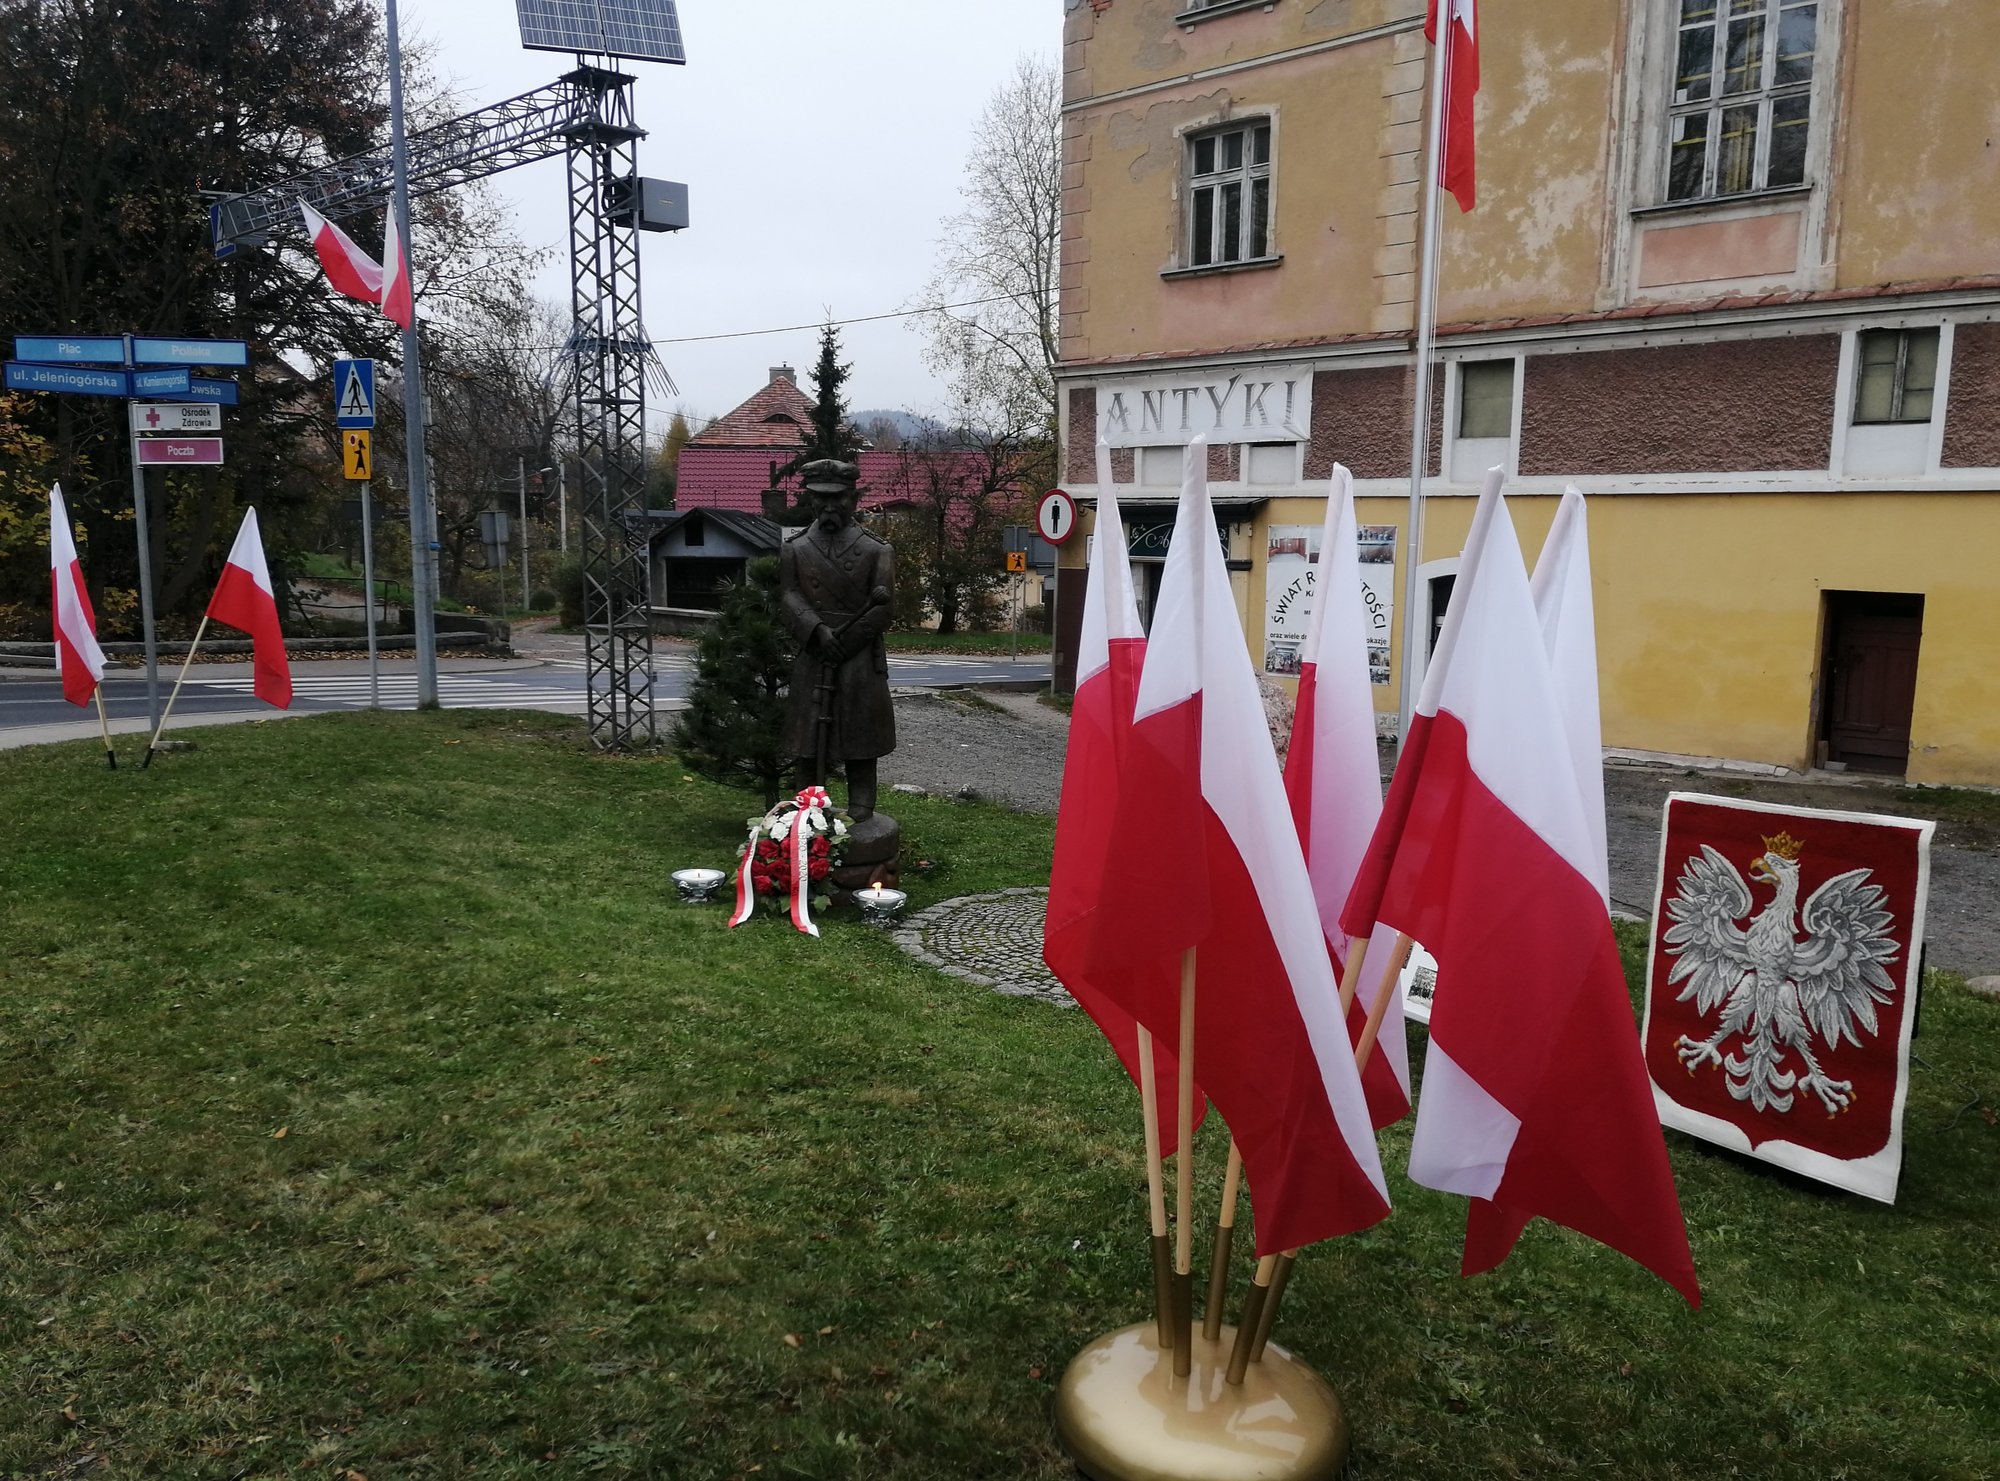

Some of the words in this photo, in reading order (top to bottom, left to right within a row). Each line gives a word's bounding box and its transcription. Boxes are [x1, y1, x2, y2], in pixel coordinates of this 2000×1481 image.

[58, 343, 81, 354] Plac
[171, 345, 211, 356] Pollaka
[13, 370, 28, 381] ul.
[32, 371, 118, 387] Jeleniogórska
[191, 385, 221, 395] owska
[1104, 373, 1300, 434] ANTYKI
[181, 407, 211, 417] Ośrodek
[182, 418, 212, 427] Zdrowia
[167, 445, 195, 456] Poczta
[1271, 578, 1302, 625] ŚWIAT
[1305, 571, 1316, 585] R
[1360, 579, 1387, 629] TOŚCI
